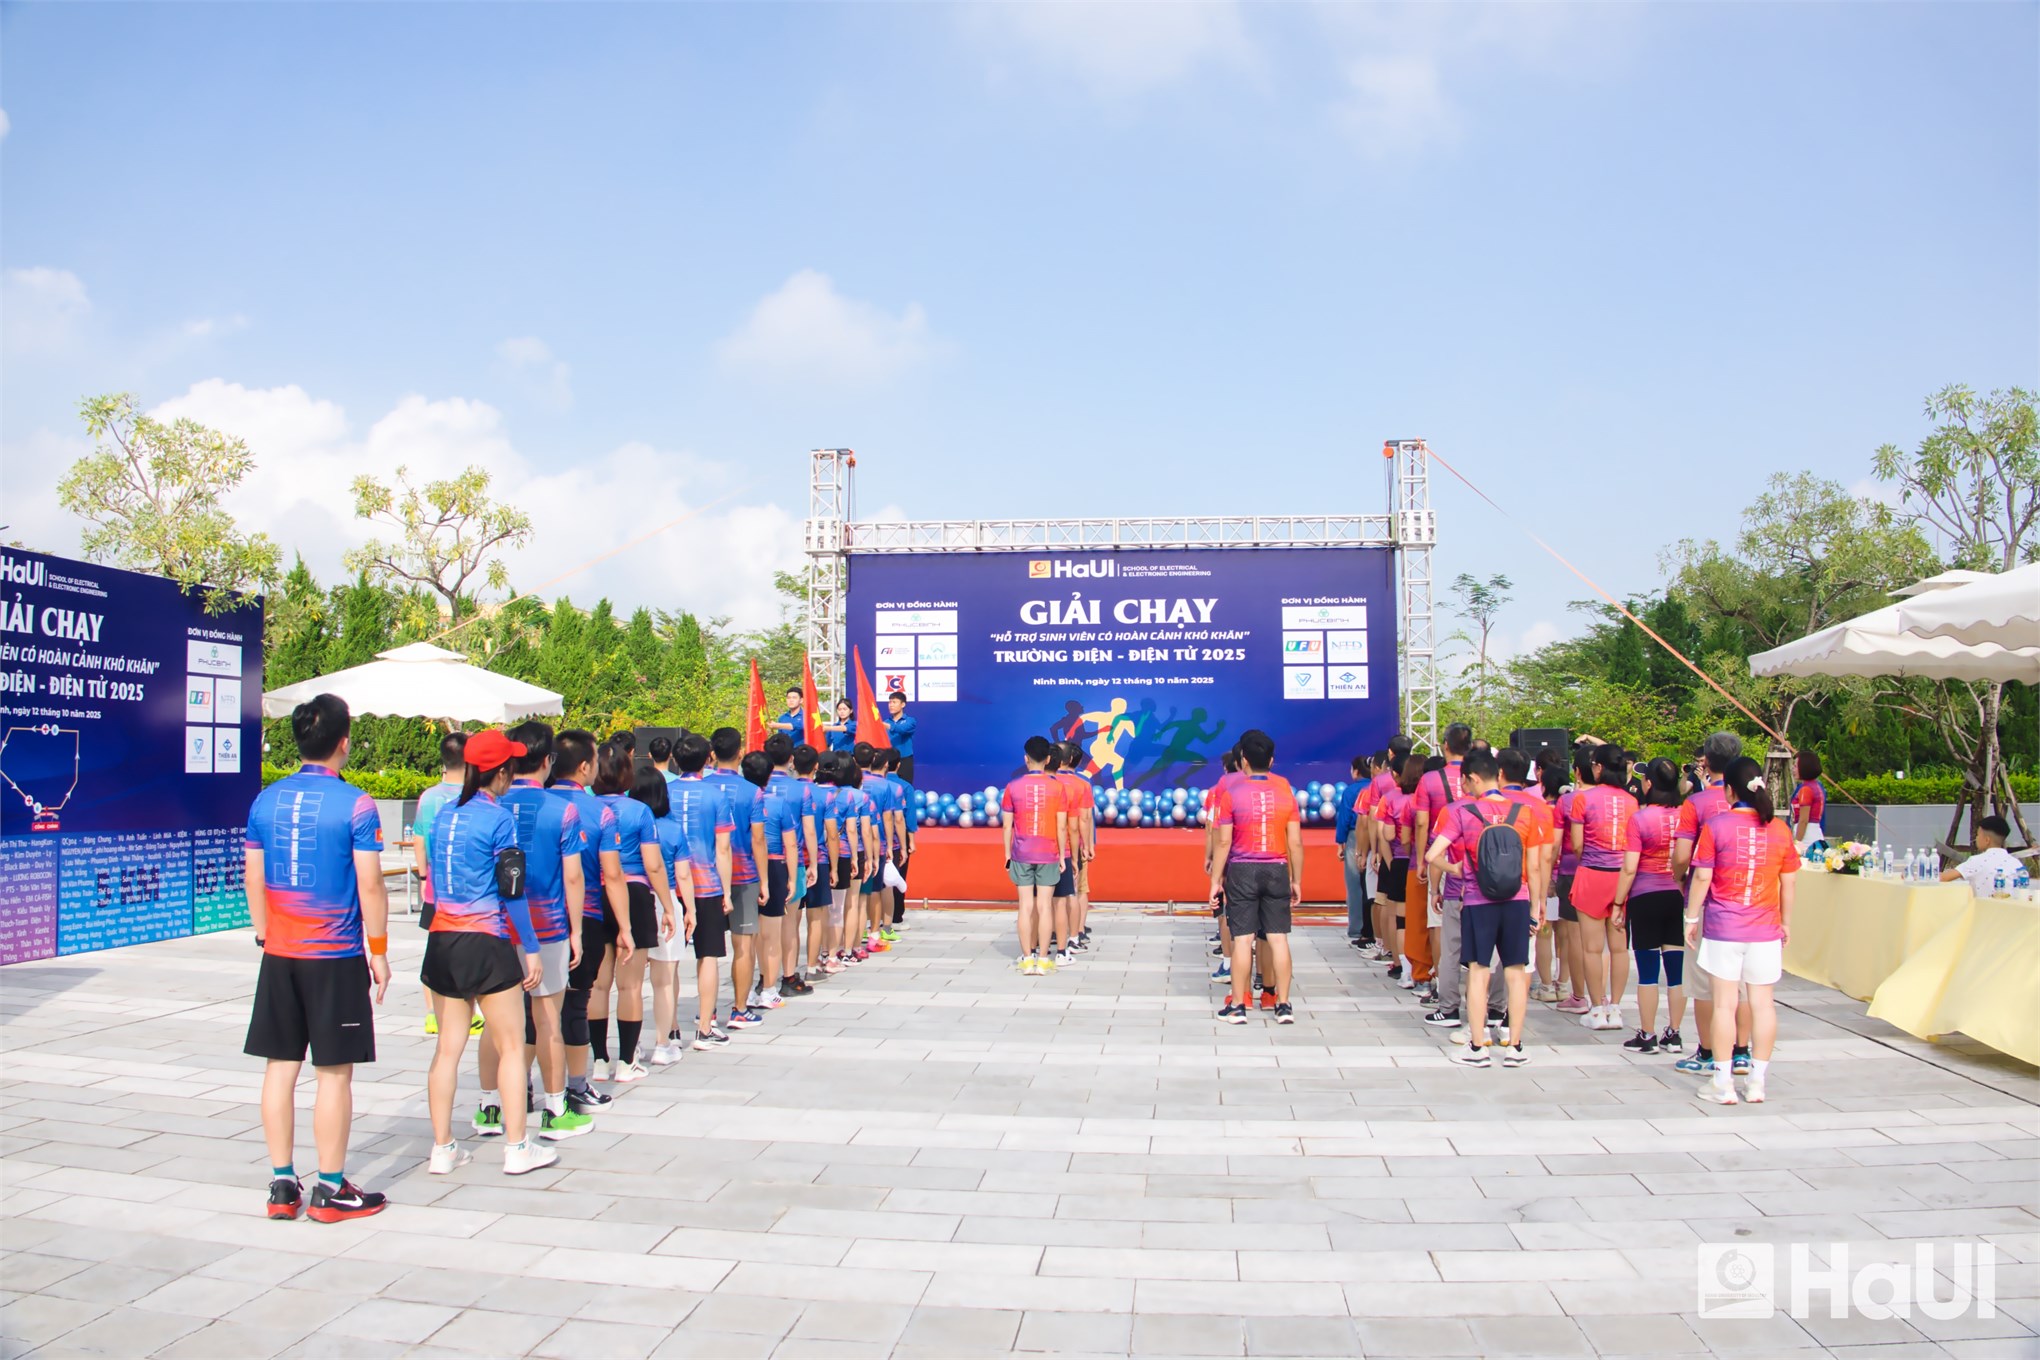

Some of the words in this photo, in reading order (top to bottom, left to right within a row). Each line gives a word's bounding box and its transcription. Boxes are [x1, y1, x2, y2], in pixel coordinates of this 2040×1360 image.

[0, 555, 44, 586] HaUI
[1054, 559, 1115, 578] HaUI
[49, 574, 67, 584] SCHOOL
[74, 578, 100, 589] ELECTRICAL
[53, 583, 80, 593] ELECTRONIC
[0, 592, 35, 634] IẢI
[41, 607, 104, 647] CHẠY
[1020, 592, 1101, 625] GIẢI
[1113, 598, 1218, 629] CHẠY
[1015, 632, 1038, 643] TRỢ
[1039, 633, 1066, 641] SINH
[1069, 631, 1096, 641] VIÊN
[1098, 631, 1113, 641] CÓ
[1115, 631, 1148, 640] HOÀN
[1150, 629, 1182, 640] CẢNH
[1184, 630, 1208, 640] KHÓ
[21, 645, 36, 662] CÓ
[38, 648, 71, 666] HOÀN
[72, 650, 102, 669] CẢNH
[103, 656, 125, 672] KHÓ
[993, 648, 1068, 663] TRƯỜNG
[1072, 648, 1112, 664] ĐIỆN
[1128, 647, 1168, 663] ĐIỆN
[1173, 645, 1198, 661] TỬ
[1202, 648, 1246, 660] 2025
[0, 669, 36, 696] ĐIỆN
[49, 674, 84, 700] ĐIỆN
[87, 674, 108, 698] TỬ
[110, 682, 144, 701] 2025
[1086, 678, 1110, 686] ngày
[1124, 677, 1152, 685] tháng
[13, 706, 31, 717] ngày
[40, 708, 60, 718] tháng
[62, 709, 69, 717] 10
[70, 709, 85, 718] năm
[86, 711, 101, 719] 2025
